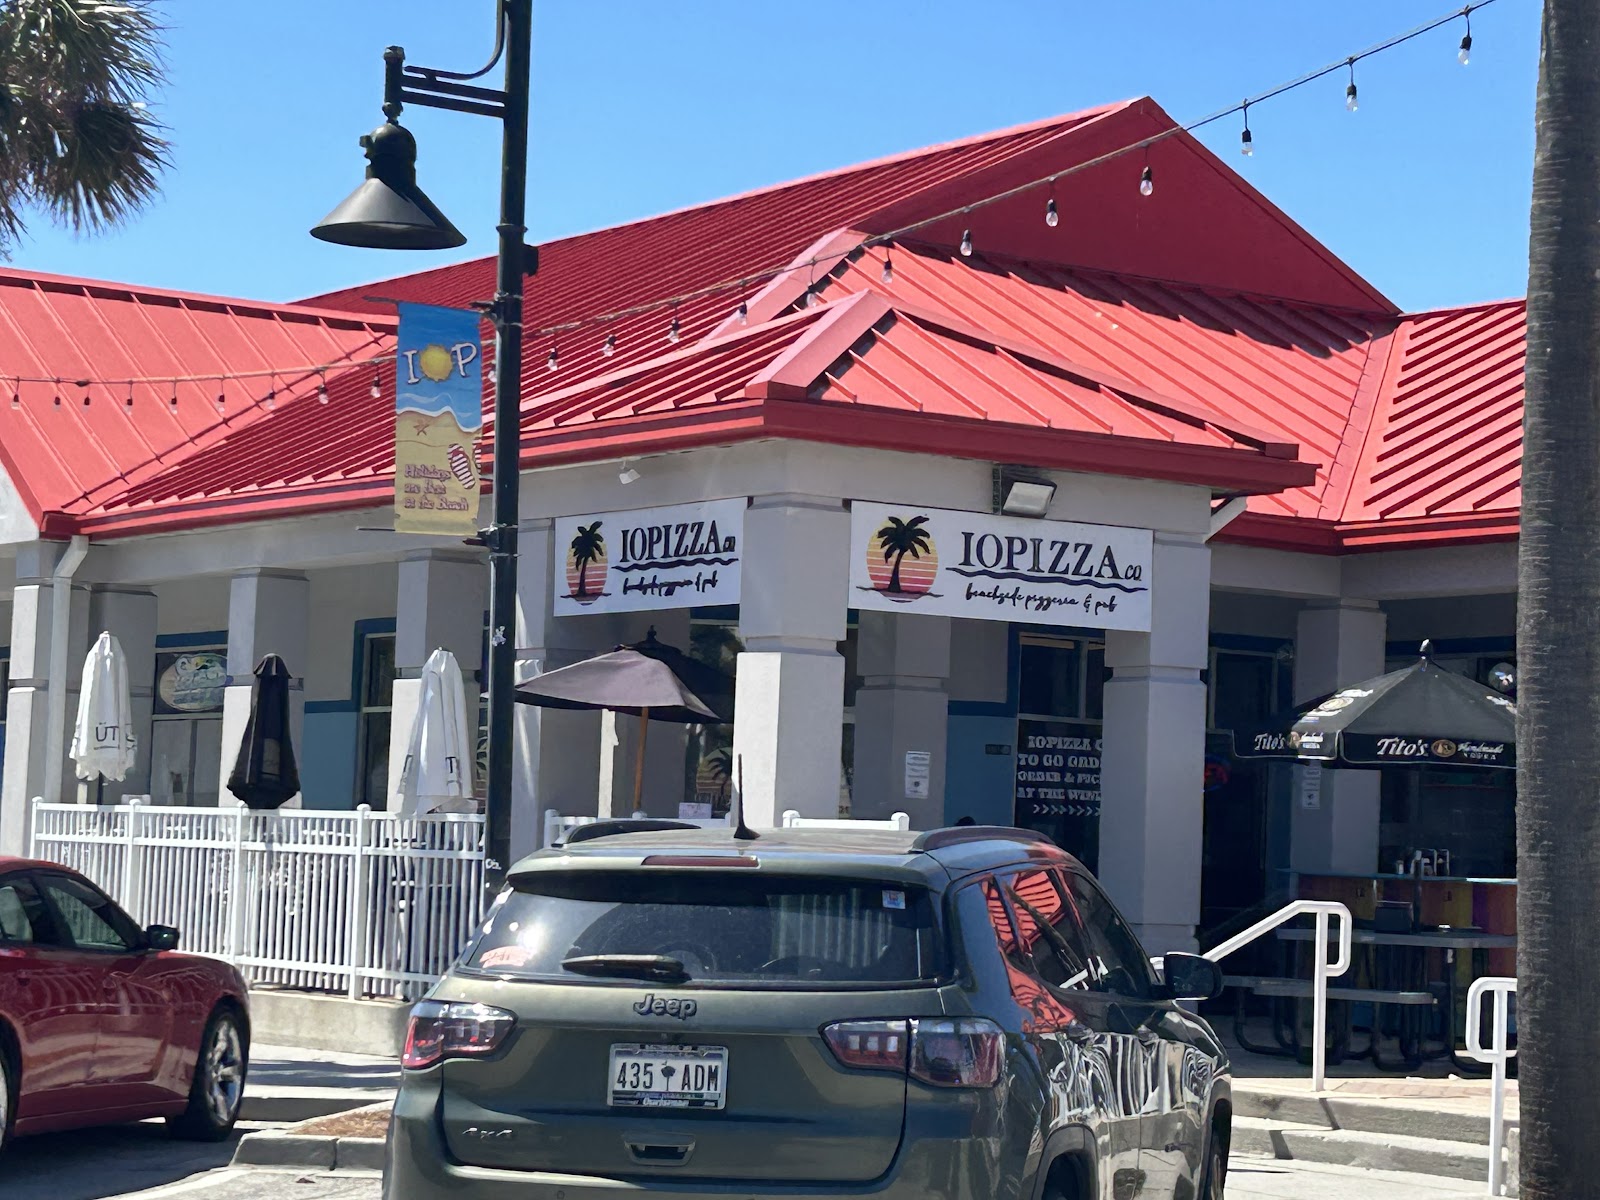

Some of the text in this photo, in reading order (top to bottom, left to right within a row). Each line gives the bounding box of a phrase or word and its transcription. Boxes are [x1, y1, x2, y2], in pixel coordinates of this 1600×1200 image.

[620, 520, 722, 562] IOPIZZA
[959, 532, 1124, 580] IOPIZZA
[1095, 595, 1118, 616] pub
[1028, 735, 1103, 752] IOPIZZA C
[1254, 732, 1286, 751] Tito's
[1376, 737, 1429, 757] Tito's
[1018, 753, 1100, 768] TO GO ORD
[1017, 771, 1100, 785] ORDER & PIC
[1017, 787, 1102, 801] AT THE WIN
[632, 993, 698, 1021] Jeep
[617, 1062, 720, 1092] 435 ADM
